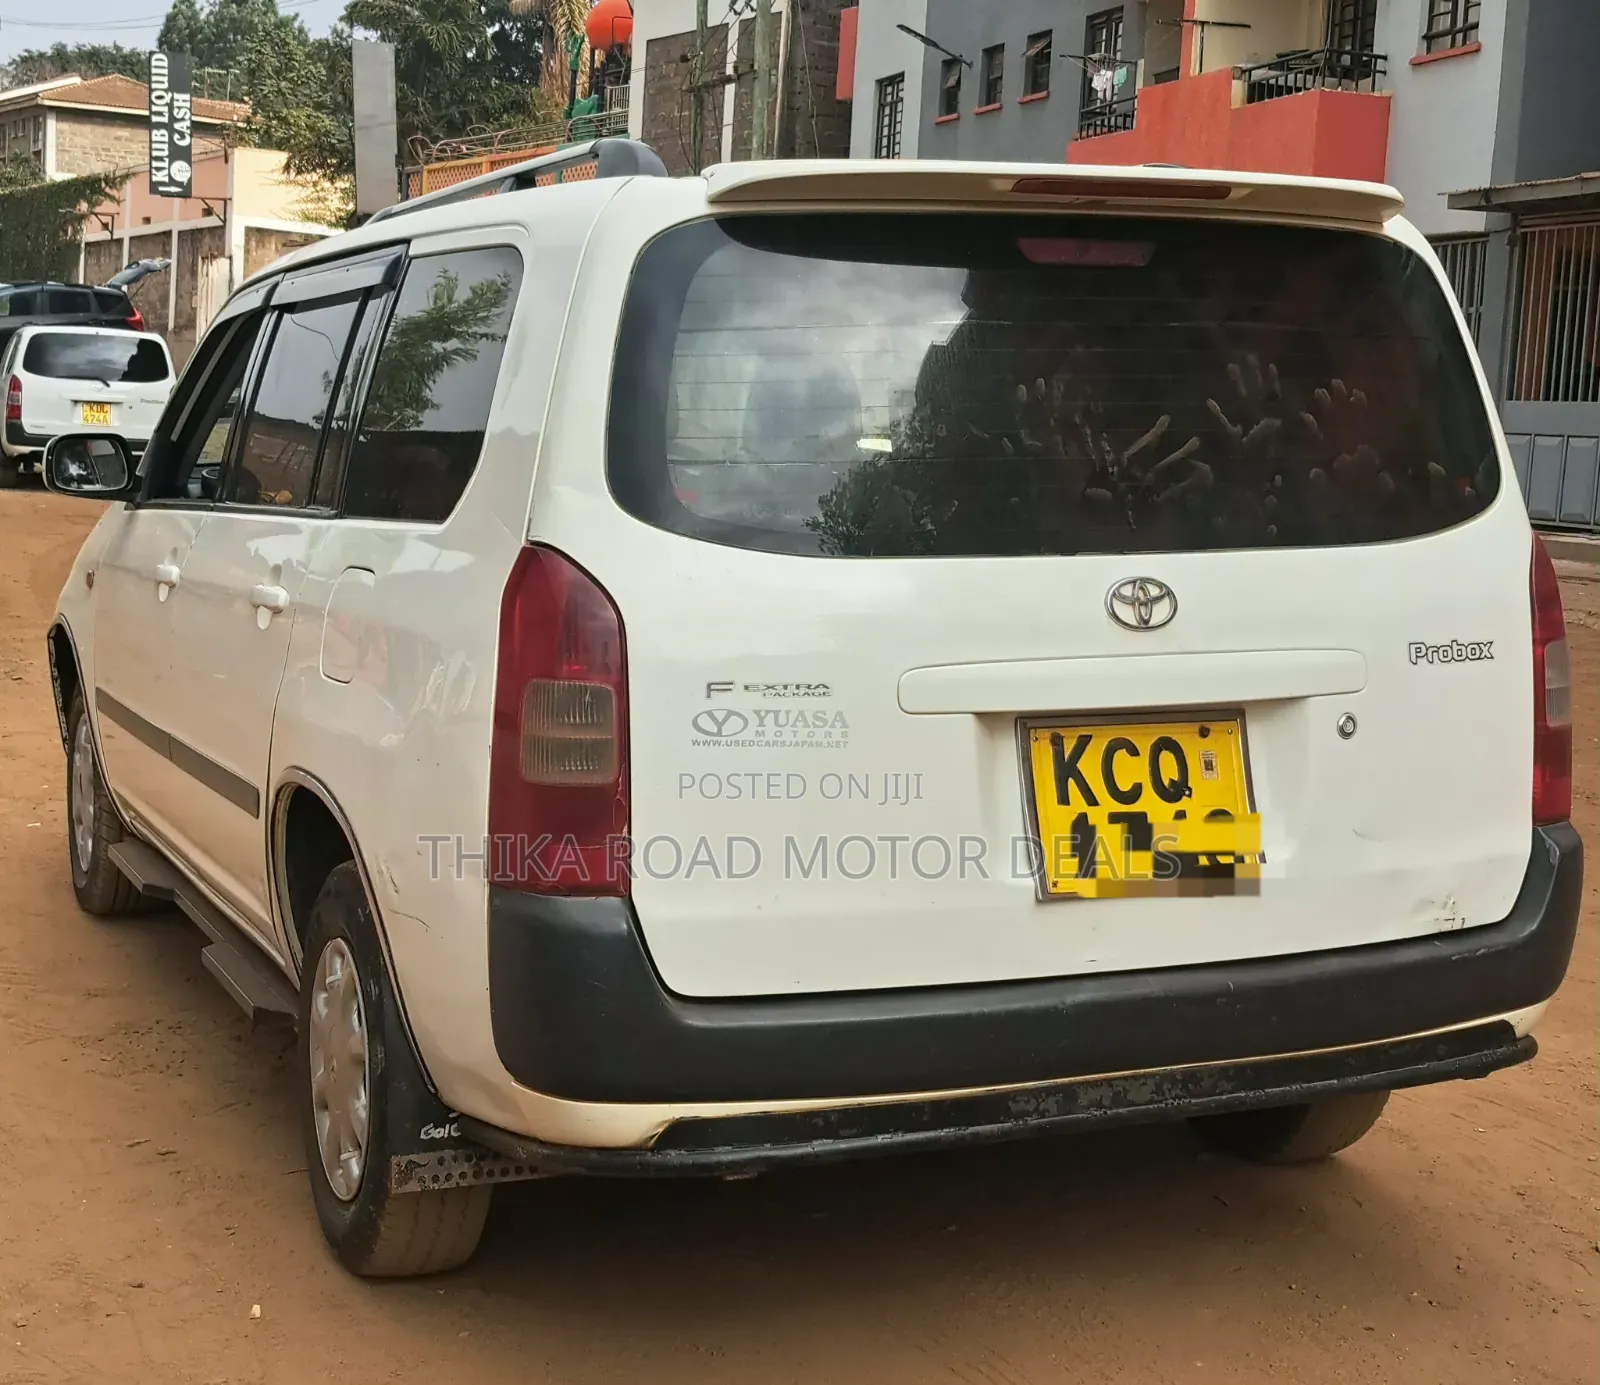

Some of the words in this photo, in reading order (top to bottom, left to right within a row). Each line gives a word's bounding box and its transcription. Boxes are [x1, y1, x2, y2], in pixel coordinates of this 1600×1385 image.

[151, 52, 172, 123] LIQUID
[173, 93, 191, 146] CASH
[151, 128, 169, 182] KLUB
[89, 403, 108, 414] KDL
[83, 414, 109, 425] 474A
[1408, 639, 1494, 665] Probox
[706, 680, 734, 699] F
[743, 683, 831, 693] EXTRA
[763, 690, 832, 698] PACKAGE
[752, 709, 850, 729] YUASA
[755, 729, 849, 739] MOTORS
[1050, 732, 1193, 807] KCQ
